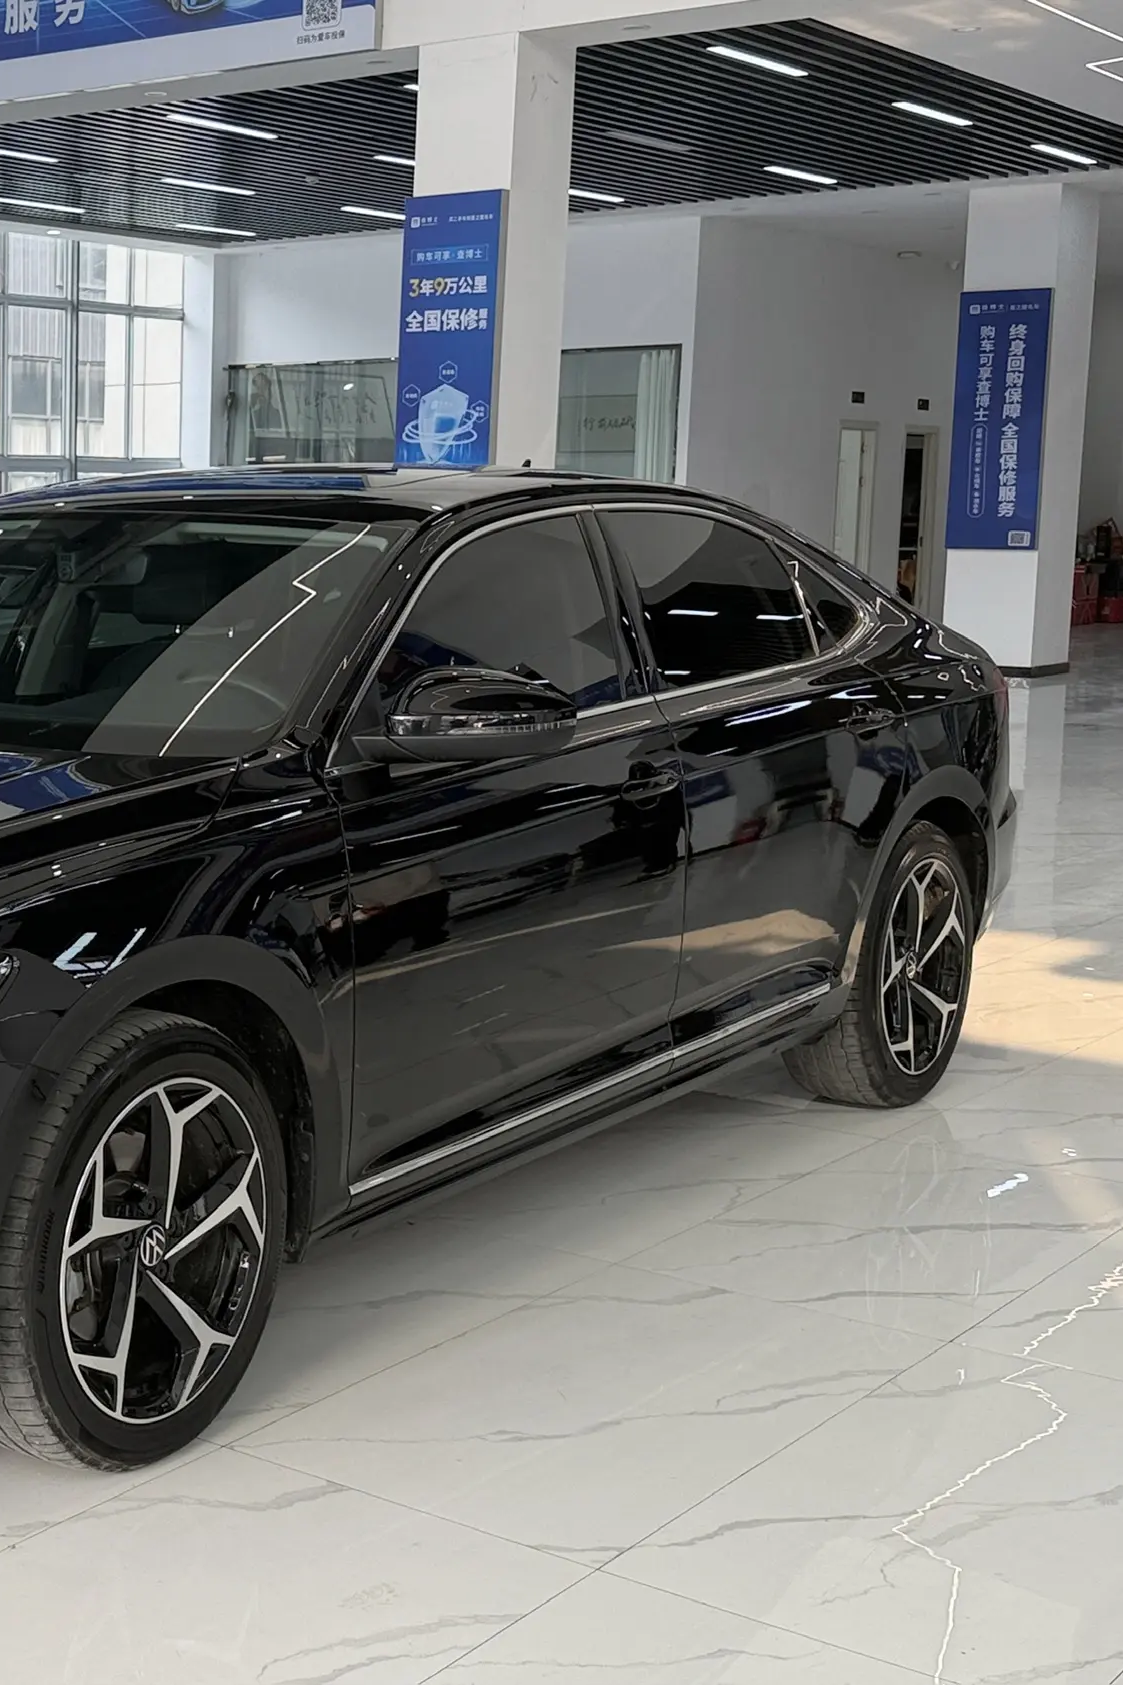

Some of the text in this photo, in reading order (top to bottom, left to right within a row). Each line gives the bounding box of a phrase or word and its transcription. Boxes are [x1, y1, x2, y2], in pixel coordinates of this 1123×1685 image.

[409, 275, 488, 297] 3年9万公里
[973, 325, 996, 421] 购车可享查博士
[1002, 324, 1028, 419] 终身回购保障
[997, 422, 1020, 517] 全国保修服务
